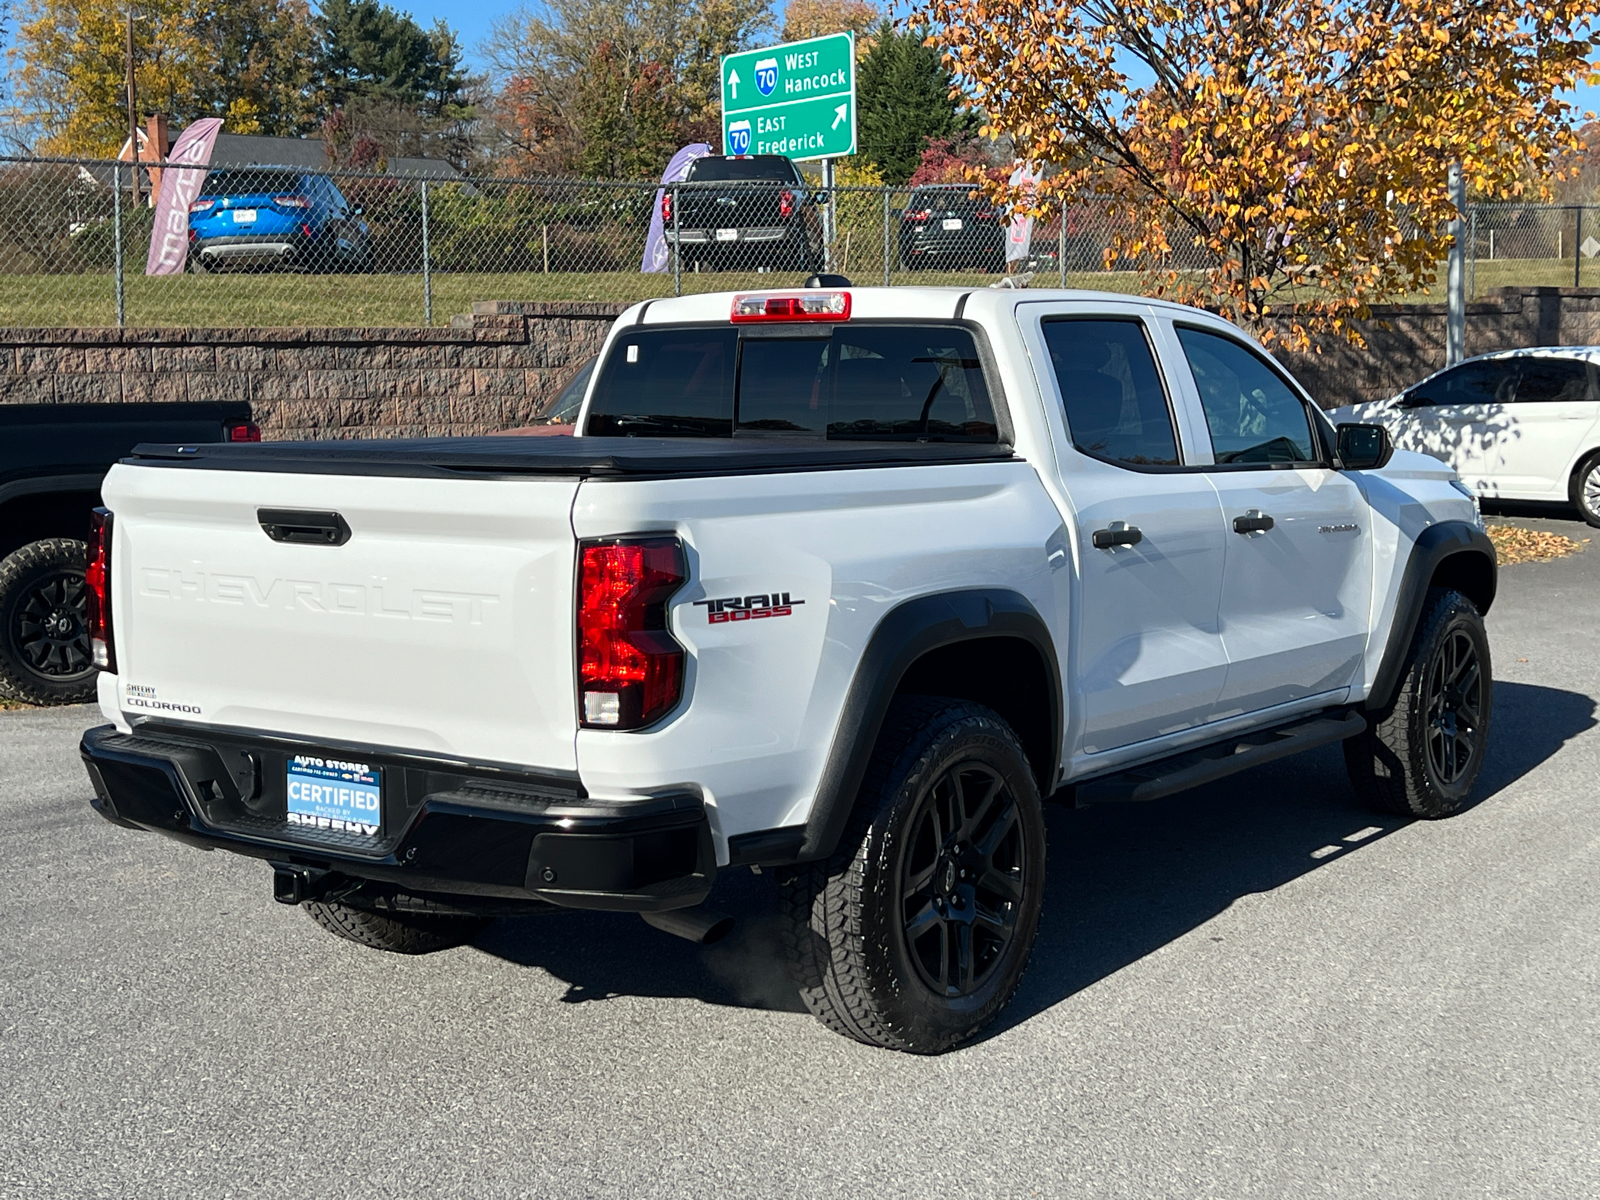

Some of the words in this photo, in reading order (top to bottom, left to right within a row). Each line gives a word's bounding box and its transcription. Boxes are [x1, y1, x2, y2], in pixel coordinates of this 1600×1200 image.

[757, 69, 775, 89] 70
[784, 52, 819, 71] WEST
[785, 68, 846, 94] Hancock
[731, 131, 748, 150] 70
[757, 116, 786, 134] EAST
[757, 132, 825, 155] Frederick
[140, 567, 500, 625] CHEVROLET
[692, 592, 806, 613] TRAIL
[708, 605, 792, 624] BOSS
[127, 698, 202, 714] COLORADO
[293, 755, 324, 767] AUTO
[325, 760, 370, 774] STORES
[289, 781, 378, 811] CERTIFIED
[315, 805, 341, 815] BACKED
